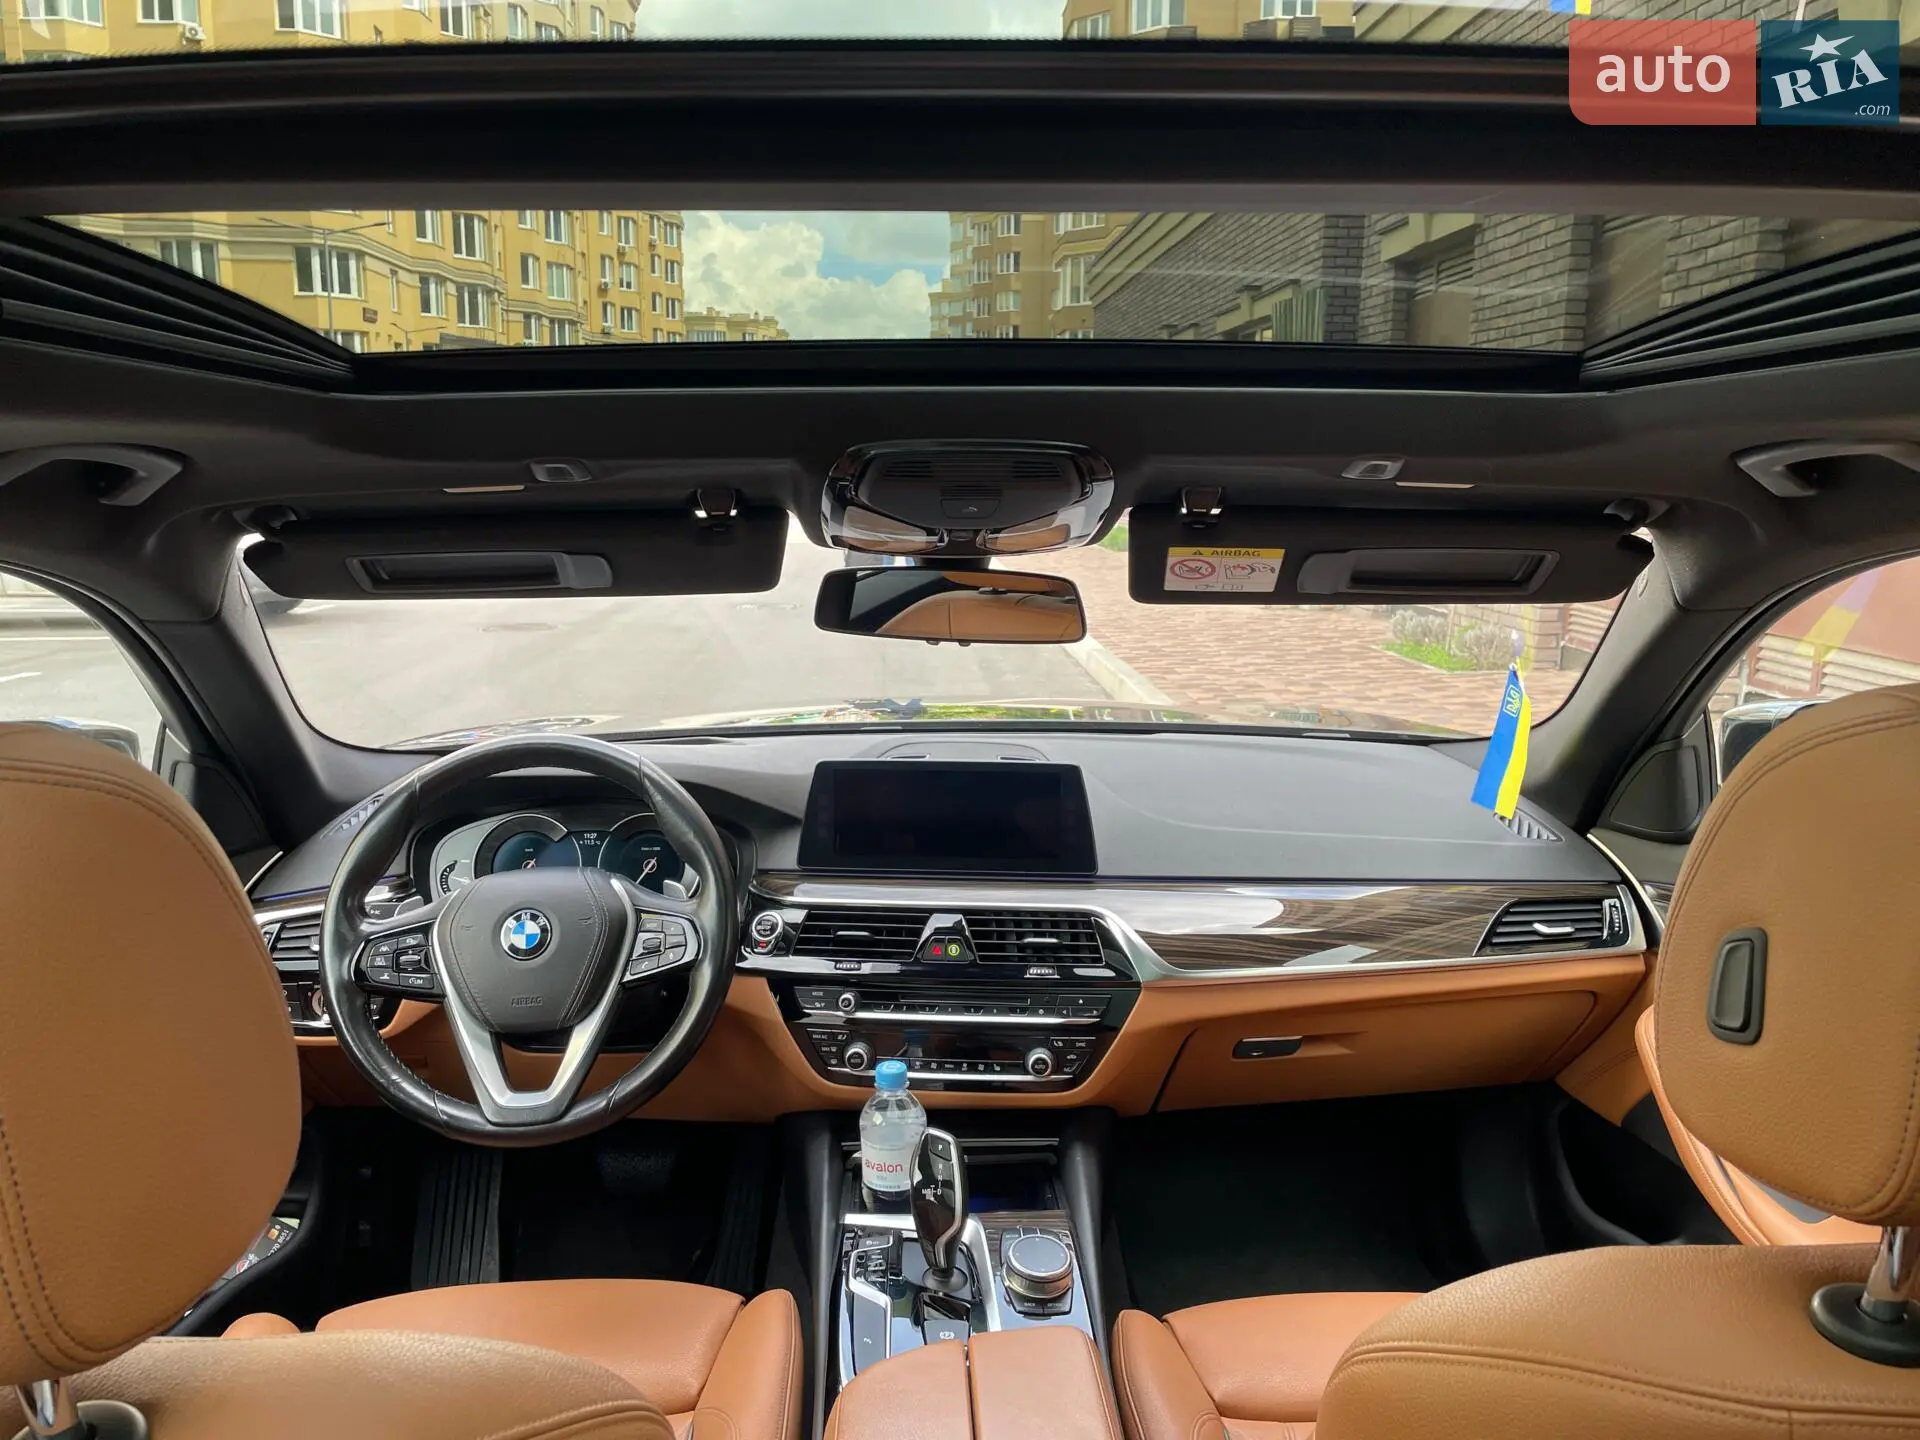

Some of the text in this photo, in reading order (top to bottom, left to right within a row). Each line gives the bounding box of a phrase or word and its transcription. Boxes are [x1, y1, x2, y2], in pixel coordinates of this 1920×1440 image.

[1210, 549, 1261, 557] AIRBAG
[507, 911, 546, 929] BMW
[511, 996, 543, 1007] AIRBAG
[864, 1159, 904, 1174] avalon
